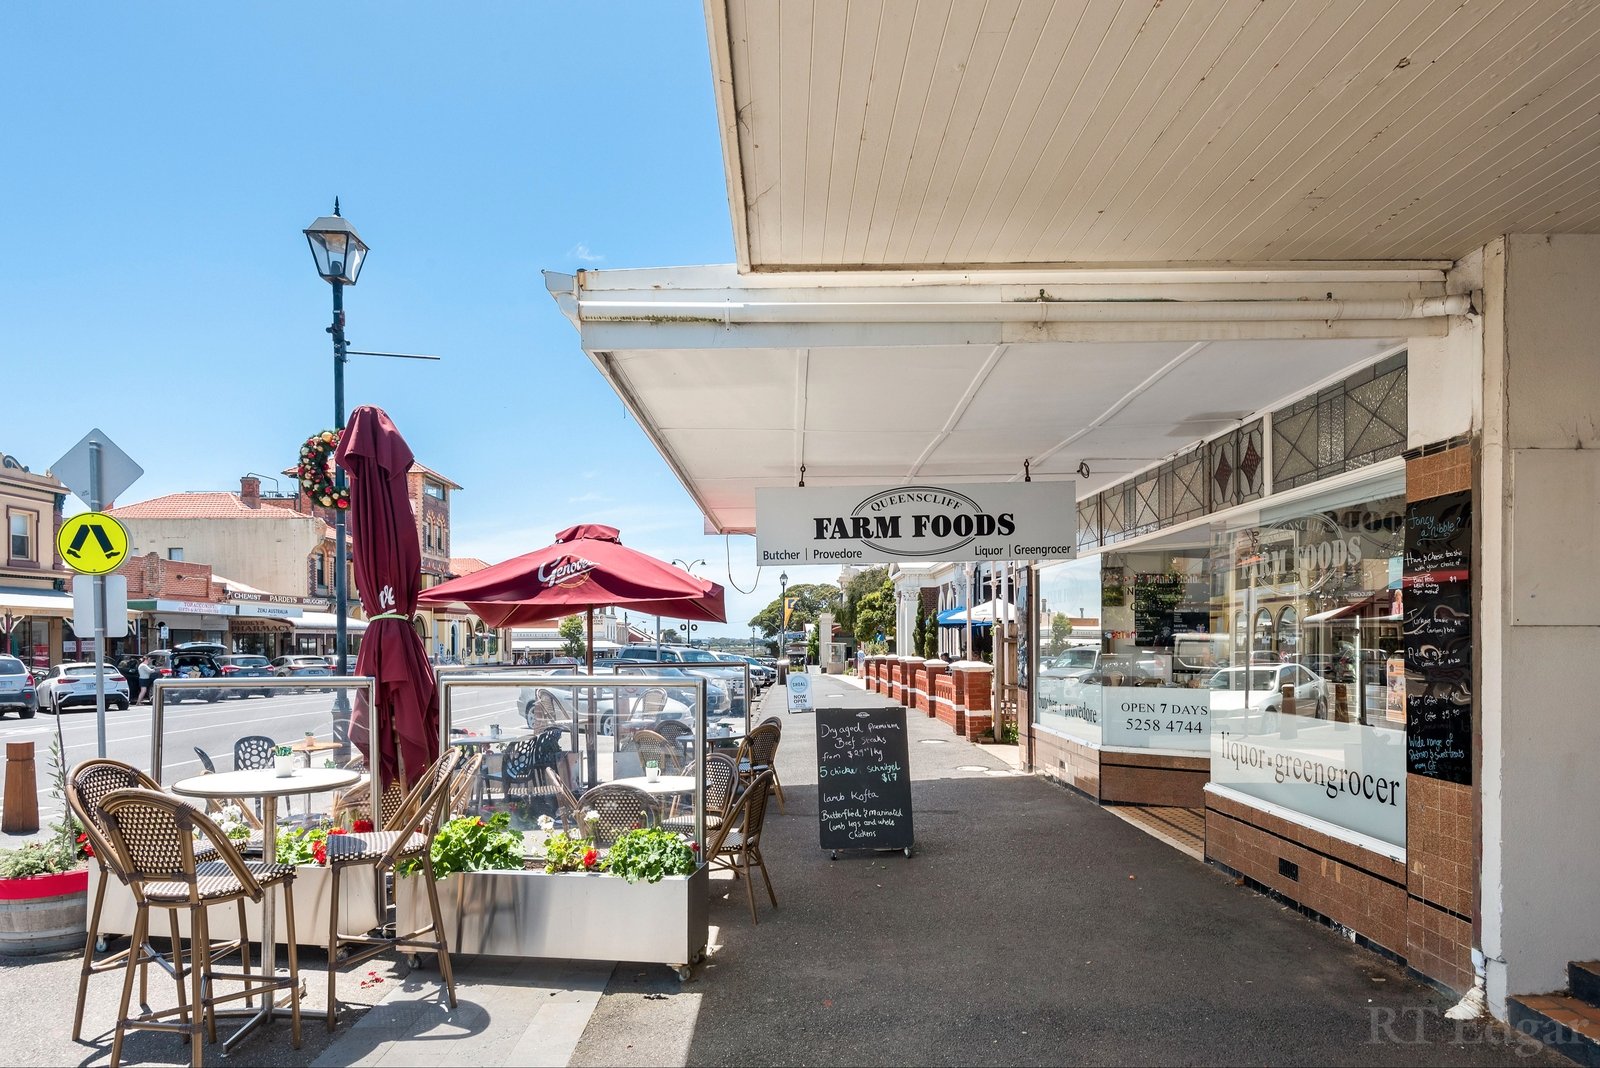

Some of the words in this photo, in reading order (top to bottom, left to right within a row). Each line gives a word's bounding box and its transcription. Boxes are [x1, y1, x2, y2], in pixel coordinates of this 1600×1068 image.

[870, 492, 963, 512] QUEENSCLIFF
[813, 516, 902, 540] FARM
[912, 513, 1016, 537] FOODS
[763, 549, 800, 561] Butcher
[813, 548, 863, 560] Provedore
[974, 545, 1004, 558] Liquor
[1014, 543, 1071, 558] Greengrocer
[1293, 535, 1362, 574] FOODS
[234, 592, 262, 600] CHEMIST
[269, 595, 298, 603] PARDEYS
[1121, 702, 1156, 715] OPEN
[1160, 703, 1168, 714] 7
[1172, 703, 1208, 716] DAYS
[1125, 718, 1161, 733] 5258
[1166, 720, 1203, 734] 4744
[820, 766, 828, 777] 5
[1221, 731, 1268, 771] liquor
[1274, 751, 1401, 807] greengrocer
[881, 773, 897, 782] $17
[864, 818, 877, 826] and
